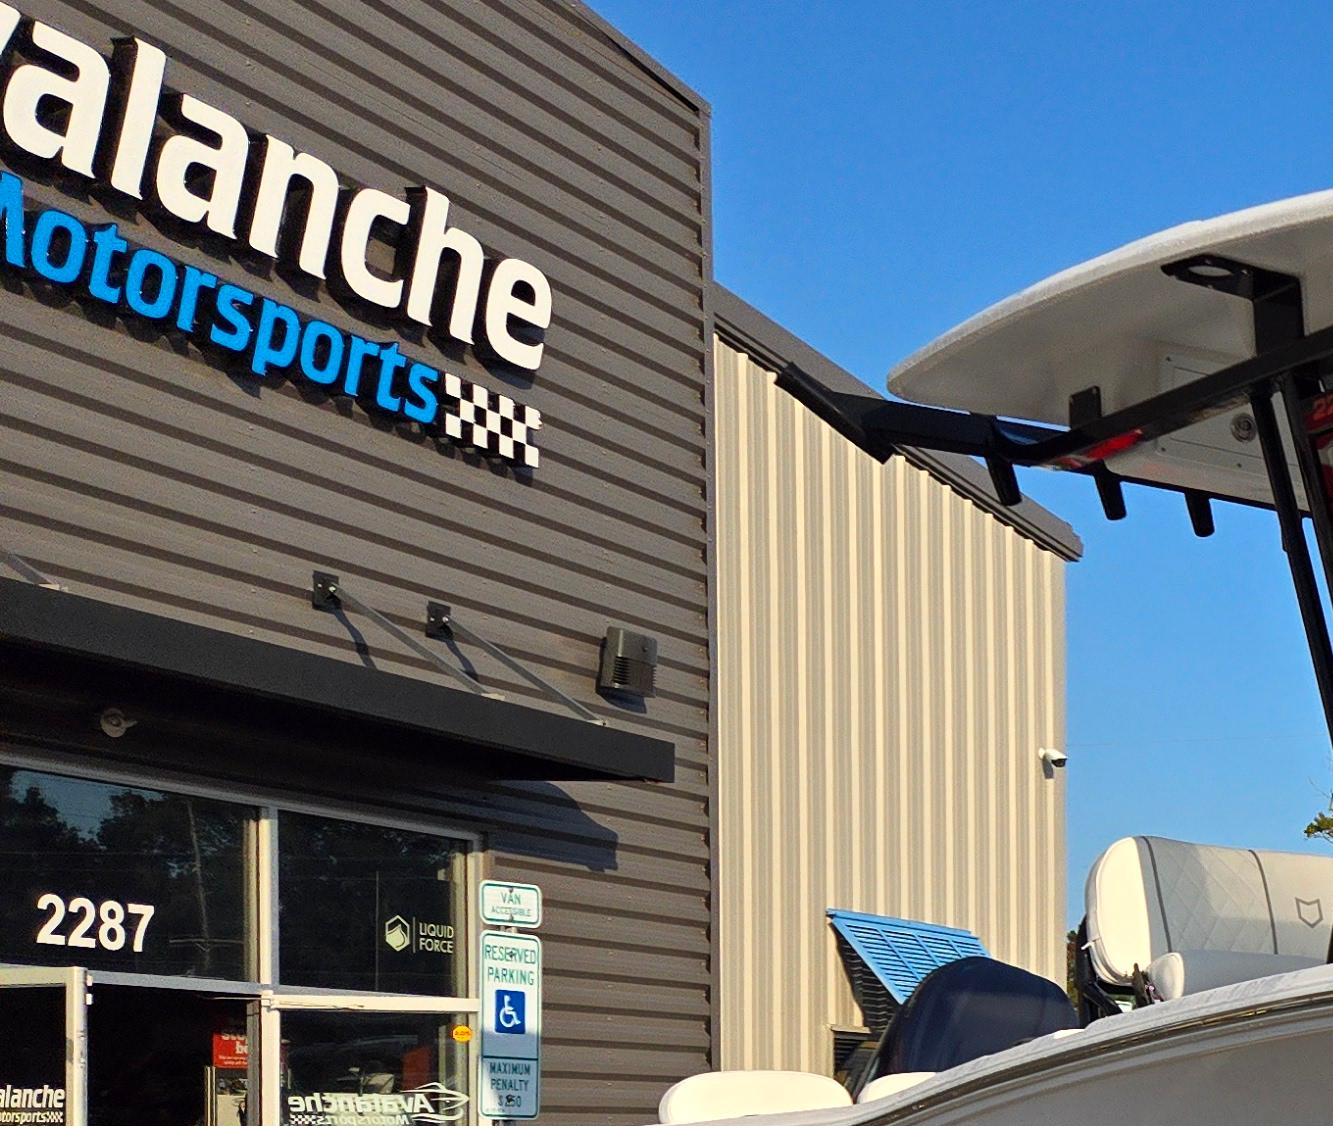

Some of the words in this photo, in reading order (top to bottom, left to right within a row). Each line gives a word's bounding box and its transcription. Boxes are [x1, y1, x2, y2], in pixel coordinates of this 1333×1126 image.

[0, 4, 553, 371] alanche
[501, 892, 521, 905] VAN
[491, 906, 531, 917] ACCESSIBLE
[36, 893, 155, 952] 2287
[419, 922, 454, 939] LIQUID
[419, 938, 454, 953] FORCE
[484, 944, 537, 965] RESERVED
[488, 967, 534, 986] PARKING
[489, 1062, 531, 1075] MAXIMUM
[490, 1079, 529, 1092] PENALTY
